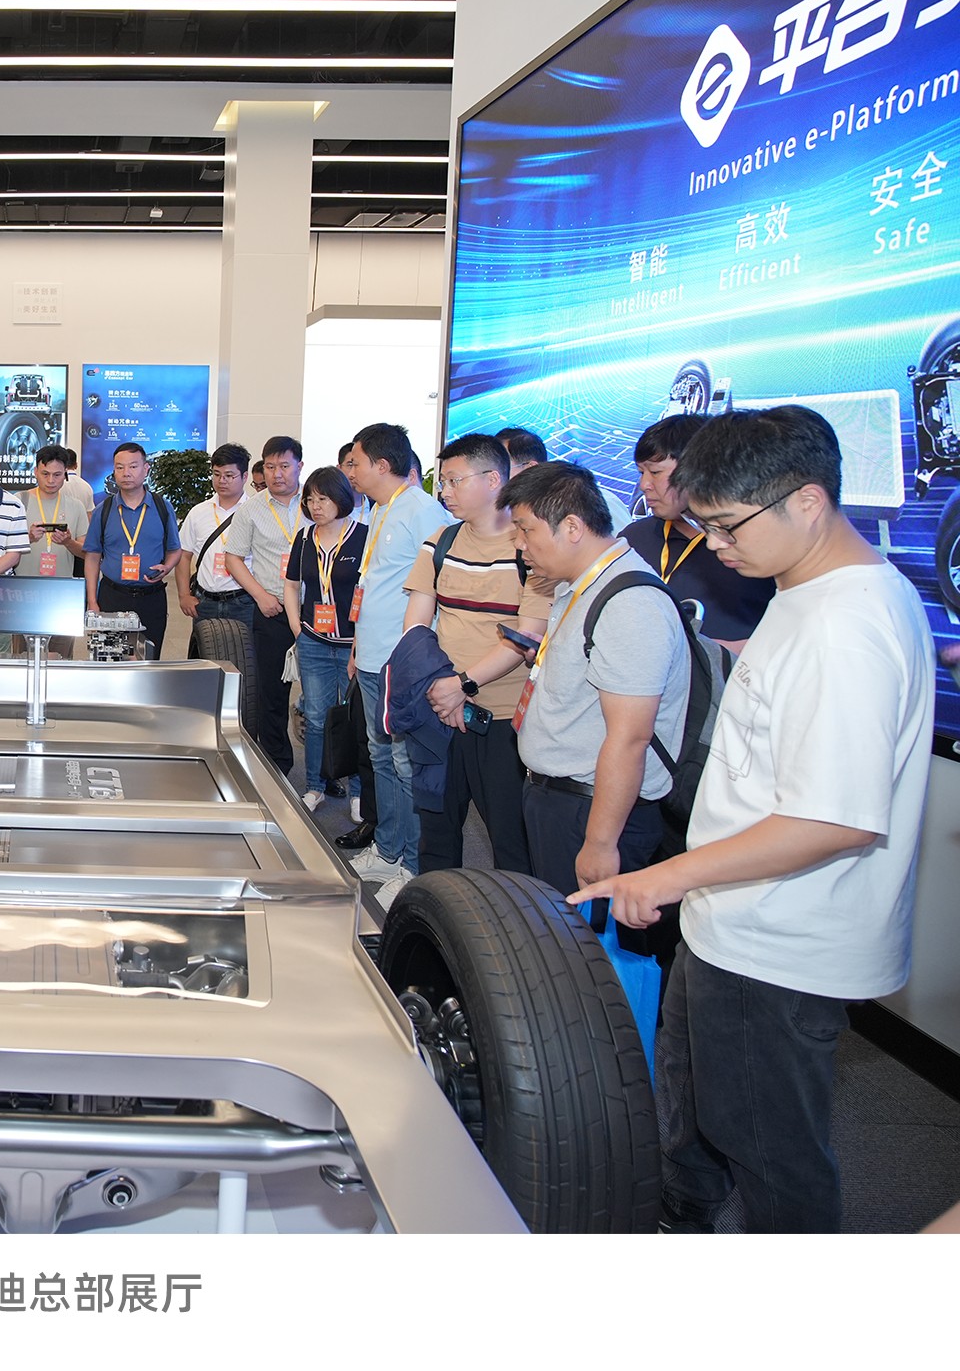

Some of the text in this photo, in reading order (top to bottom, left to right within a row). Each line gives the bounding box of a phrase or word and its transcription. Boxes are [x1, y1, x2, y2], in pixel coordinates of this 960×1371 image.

[688, 69, 960, 196] Innovative e-Platform
[610, 217, 930, 316] Intelligent Efficient Safe
[629, 151, 949, 284] 智能 高效 安全
